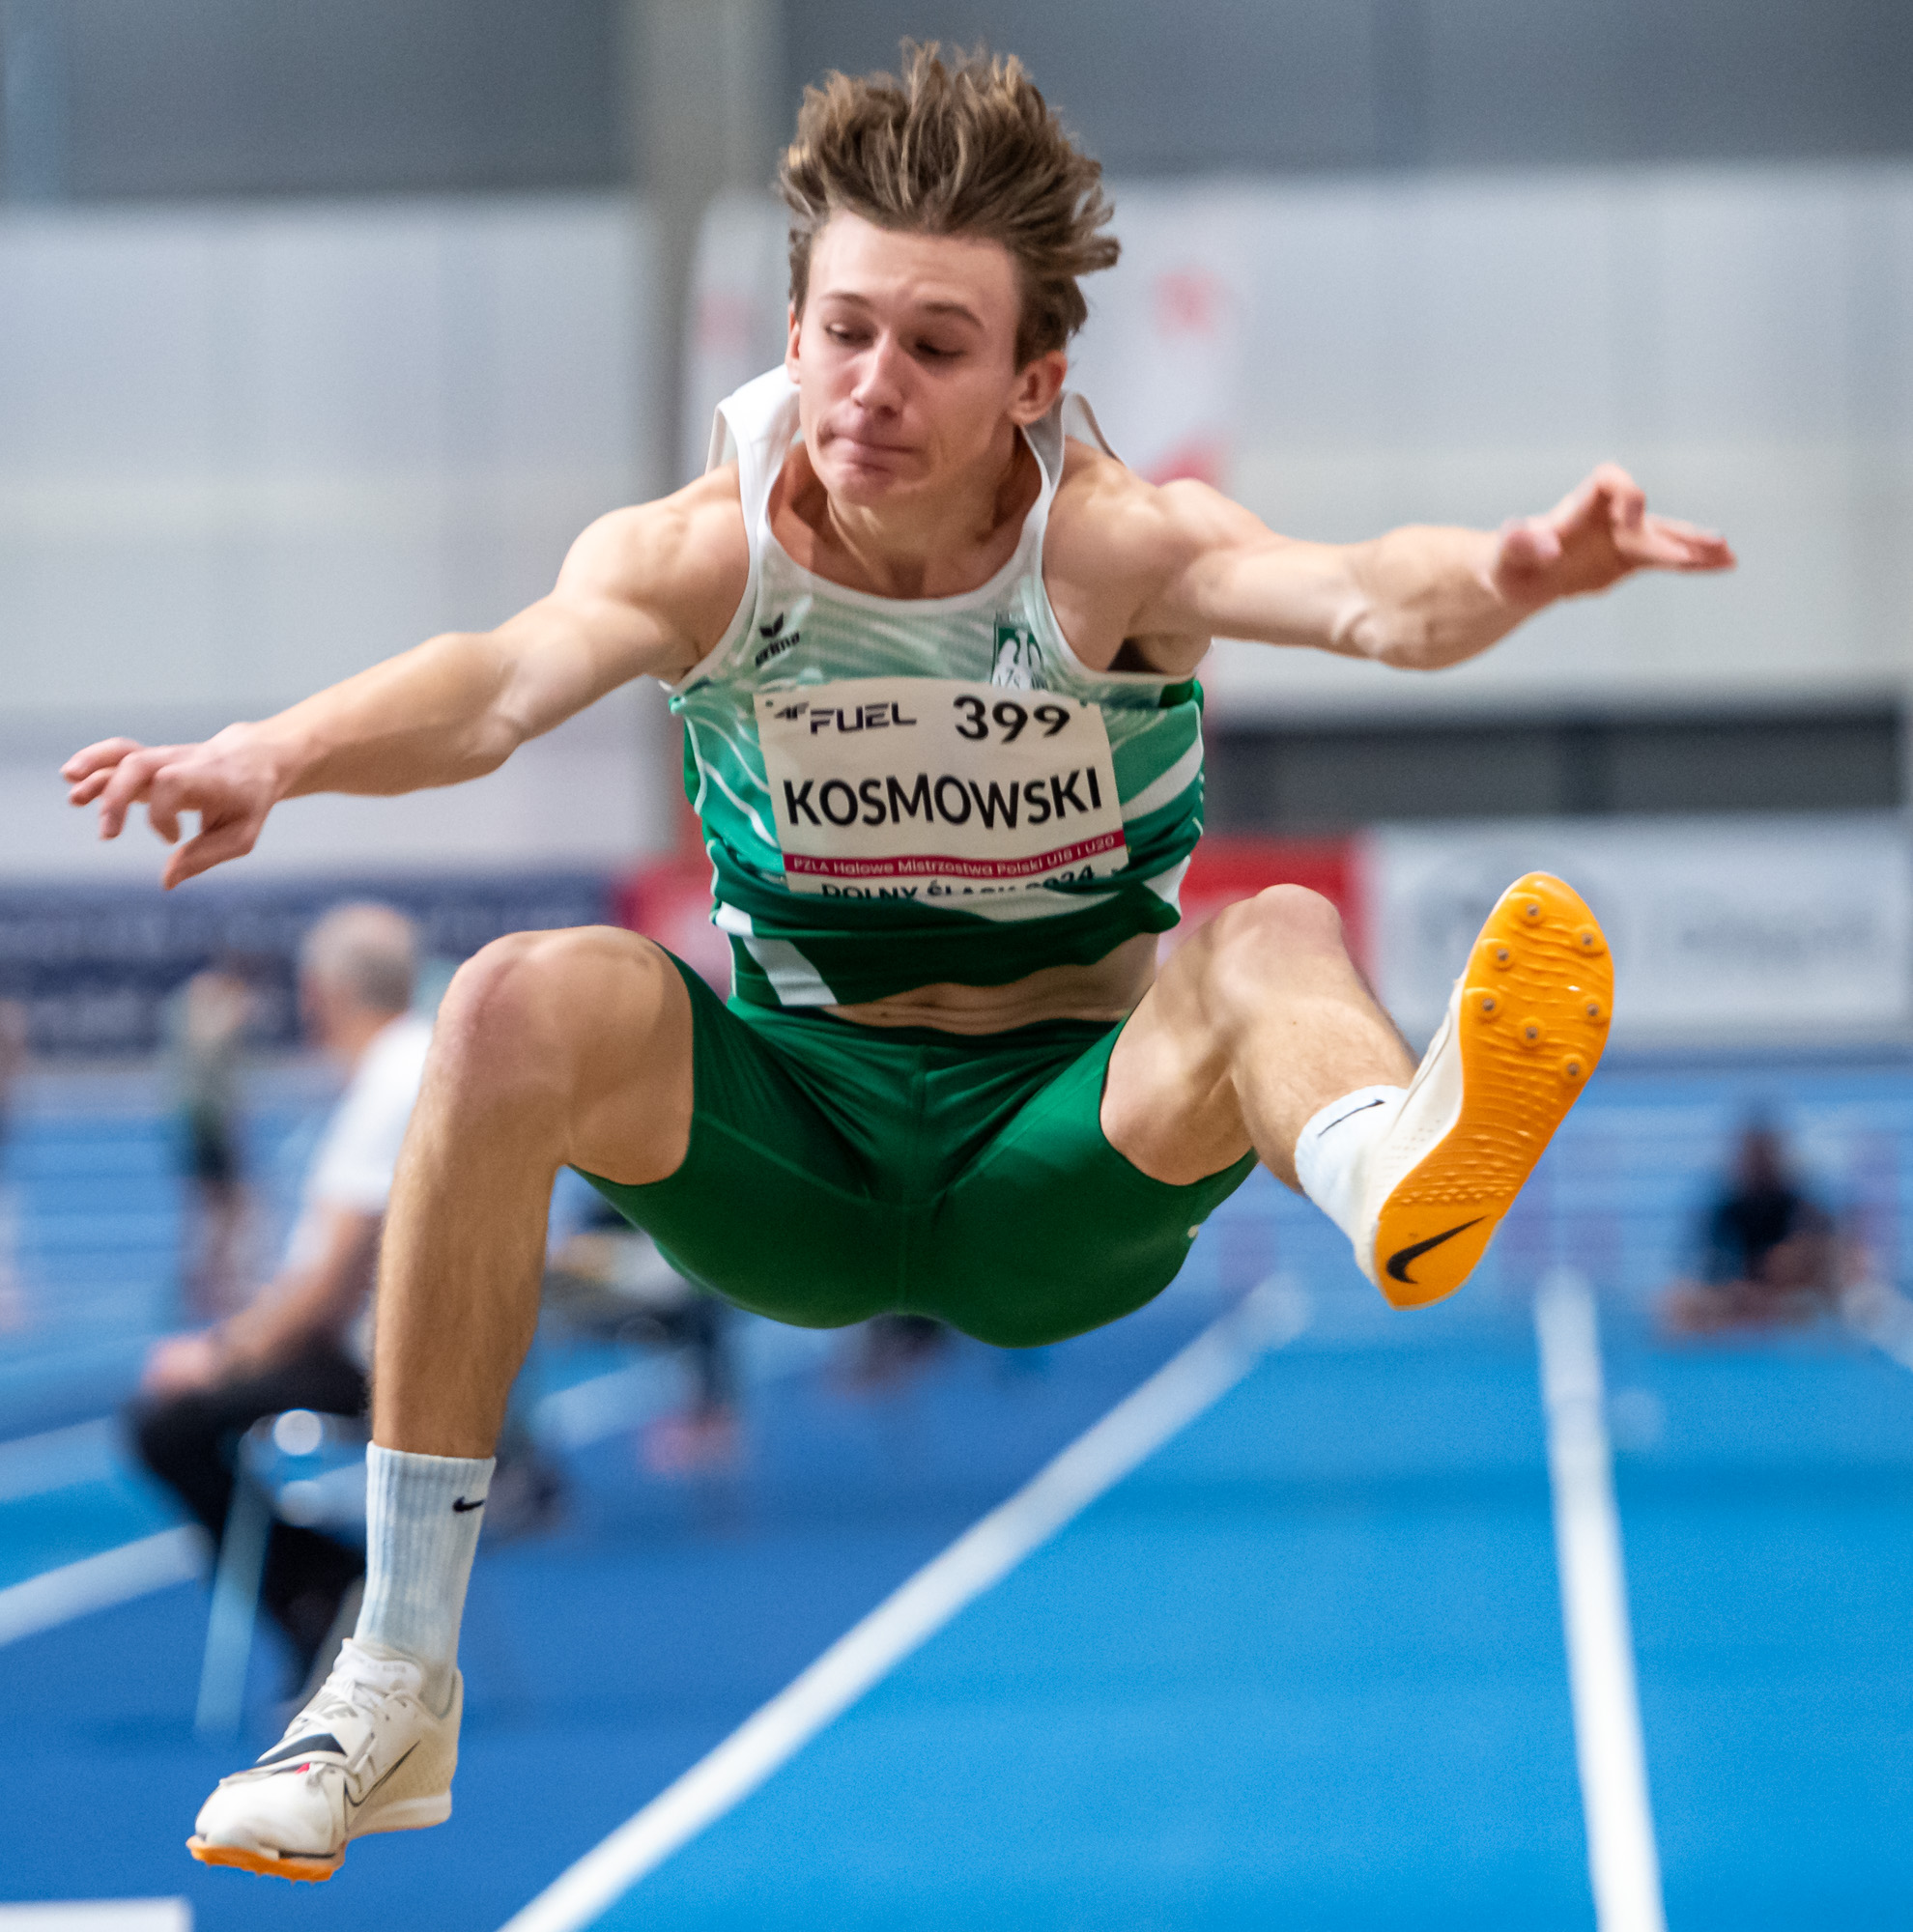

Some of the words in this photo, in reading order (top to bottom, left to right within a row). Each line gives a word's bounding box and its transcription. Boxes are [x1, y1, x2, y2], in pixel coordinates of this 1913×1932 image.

[810, 701, 917, 734] FUEL
[953, 695, 1071, 744] 399
[784, 767, 1102, 829] KOSMOWSKI
[793, 858, 829, 872] PZLA
[834, 861, 894, 874] Halowe
[899, 860, 993, 875] Mistrzostwa
[997, 859, 1043, 875] Polski
[1046, 849, 1072, 867] U18
[1085, 835, 1115, 853] U20
